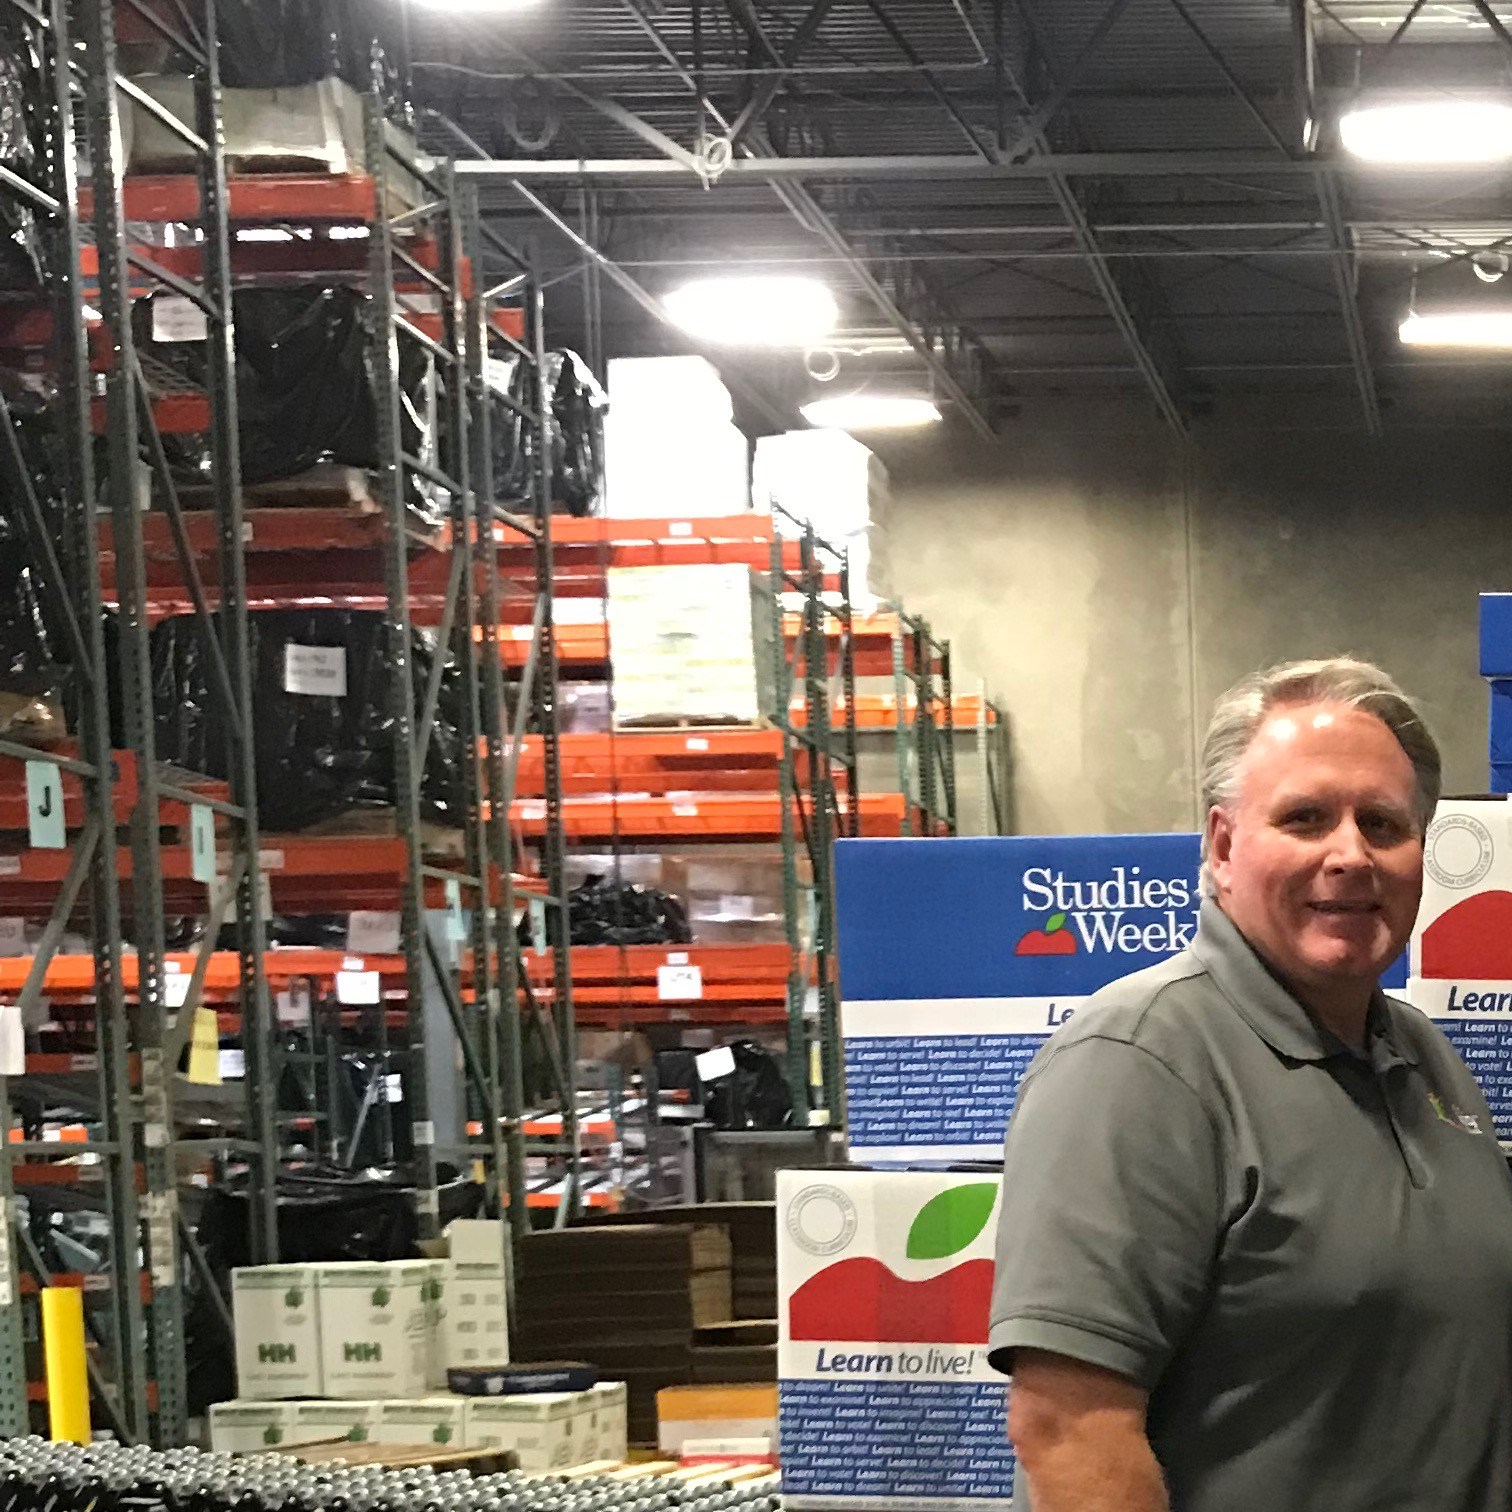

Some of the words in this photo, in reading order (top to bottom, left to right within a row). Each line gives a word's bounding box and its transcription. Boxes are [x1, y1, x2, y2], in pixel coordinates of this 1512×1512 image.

[38, 786, 51, 817] J
[1022, 867, 1190, 911] Studies
[1071, 910, 1200, 953] Week
[1465, 1022, 1495, 1032] Learn
[1498, 1023, 1508, 1032] to
[913, 1039, 941, 1047] Learn
[981, 1038, 1009, 1046] Learn
[857, 1052, 886, 1060] Learn
[1004, 1049, 1033, 1057] Learn
[1466, 1048, 1496, 1058] Learn
[1499, 1049, 1509, 1058] to
[984, 1061, 1013, 1069] Learn
[937, 1073, 965, 1082] Learn
[1485, 1075, 1495, 1084] to
[972, 1085, 1000, 1093] Learn
[964, 1108, 993, 1116] Learn
[259, 1342, 296, 1362] HH
[343, 1342, 382, 1362] HH
[816, 1348, 892, 1372] Learn
[899, 1351, 922, 1374] to
[926, 1348, 974, 1374] live!
[909, 1384, 939, 1393] Learn
[972, 1397, 1001, 1406] Learn
[926, 1409, 956, 1418] Learn
[965, 1422, 995, 1431] Learn
[969, 1459, 999, 1468] Learn
